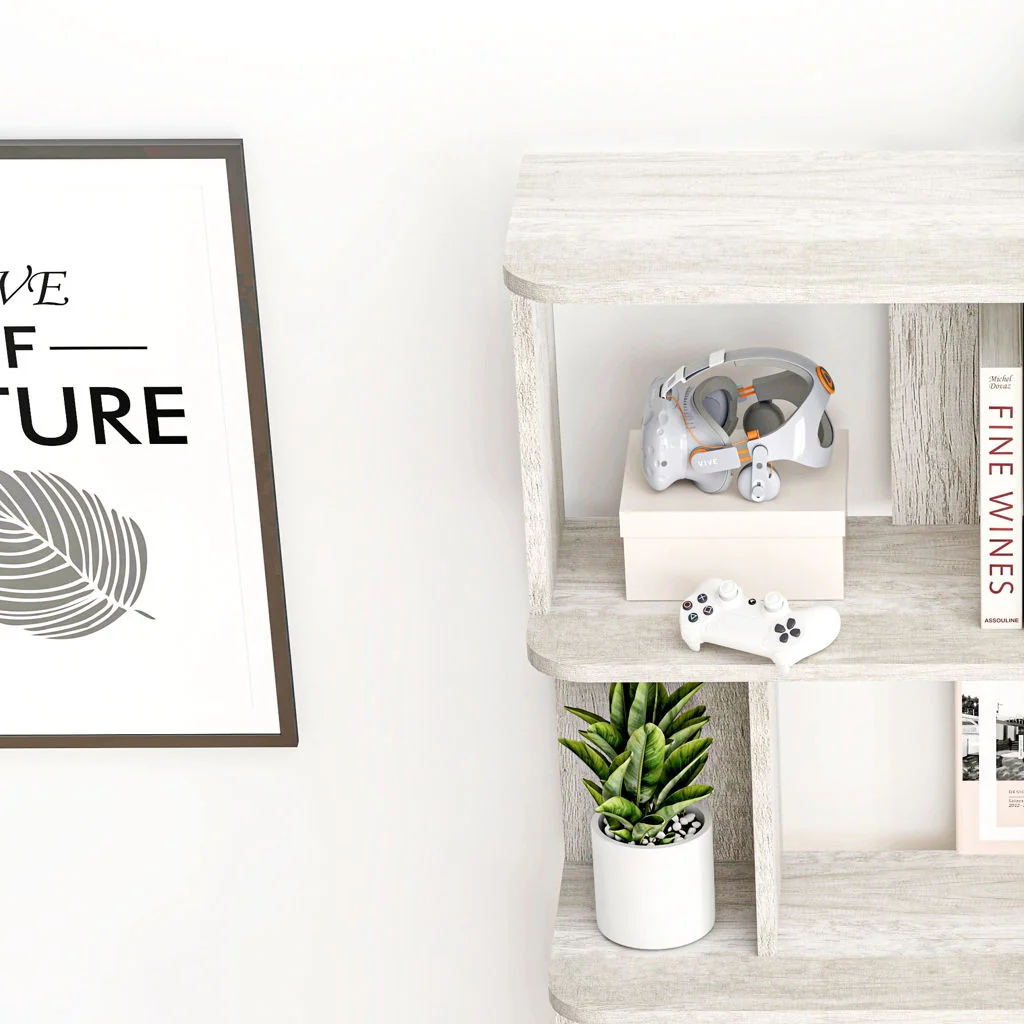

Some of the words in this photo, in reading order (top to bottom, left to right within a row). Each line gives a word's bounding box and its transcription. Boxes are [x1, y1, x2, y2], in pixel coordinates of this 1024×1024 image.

[988, 375, 1014, 383] Michel
[988, 406, 1014, 475] FINE
[988, 491, 1014, 595] WINES
